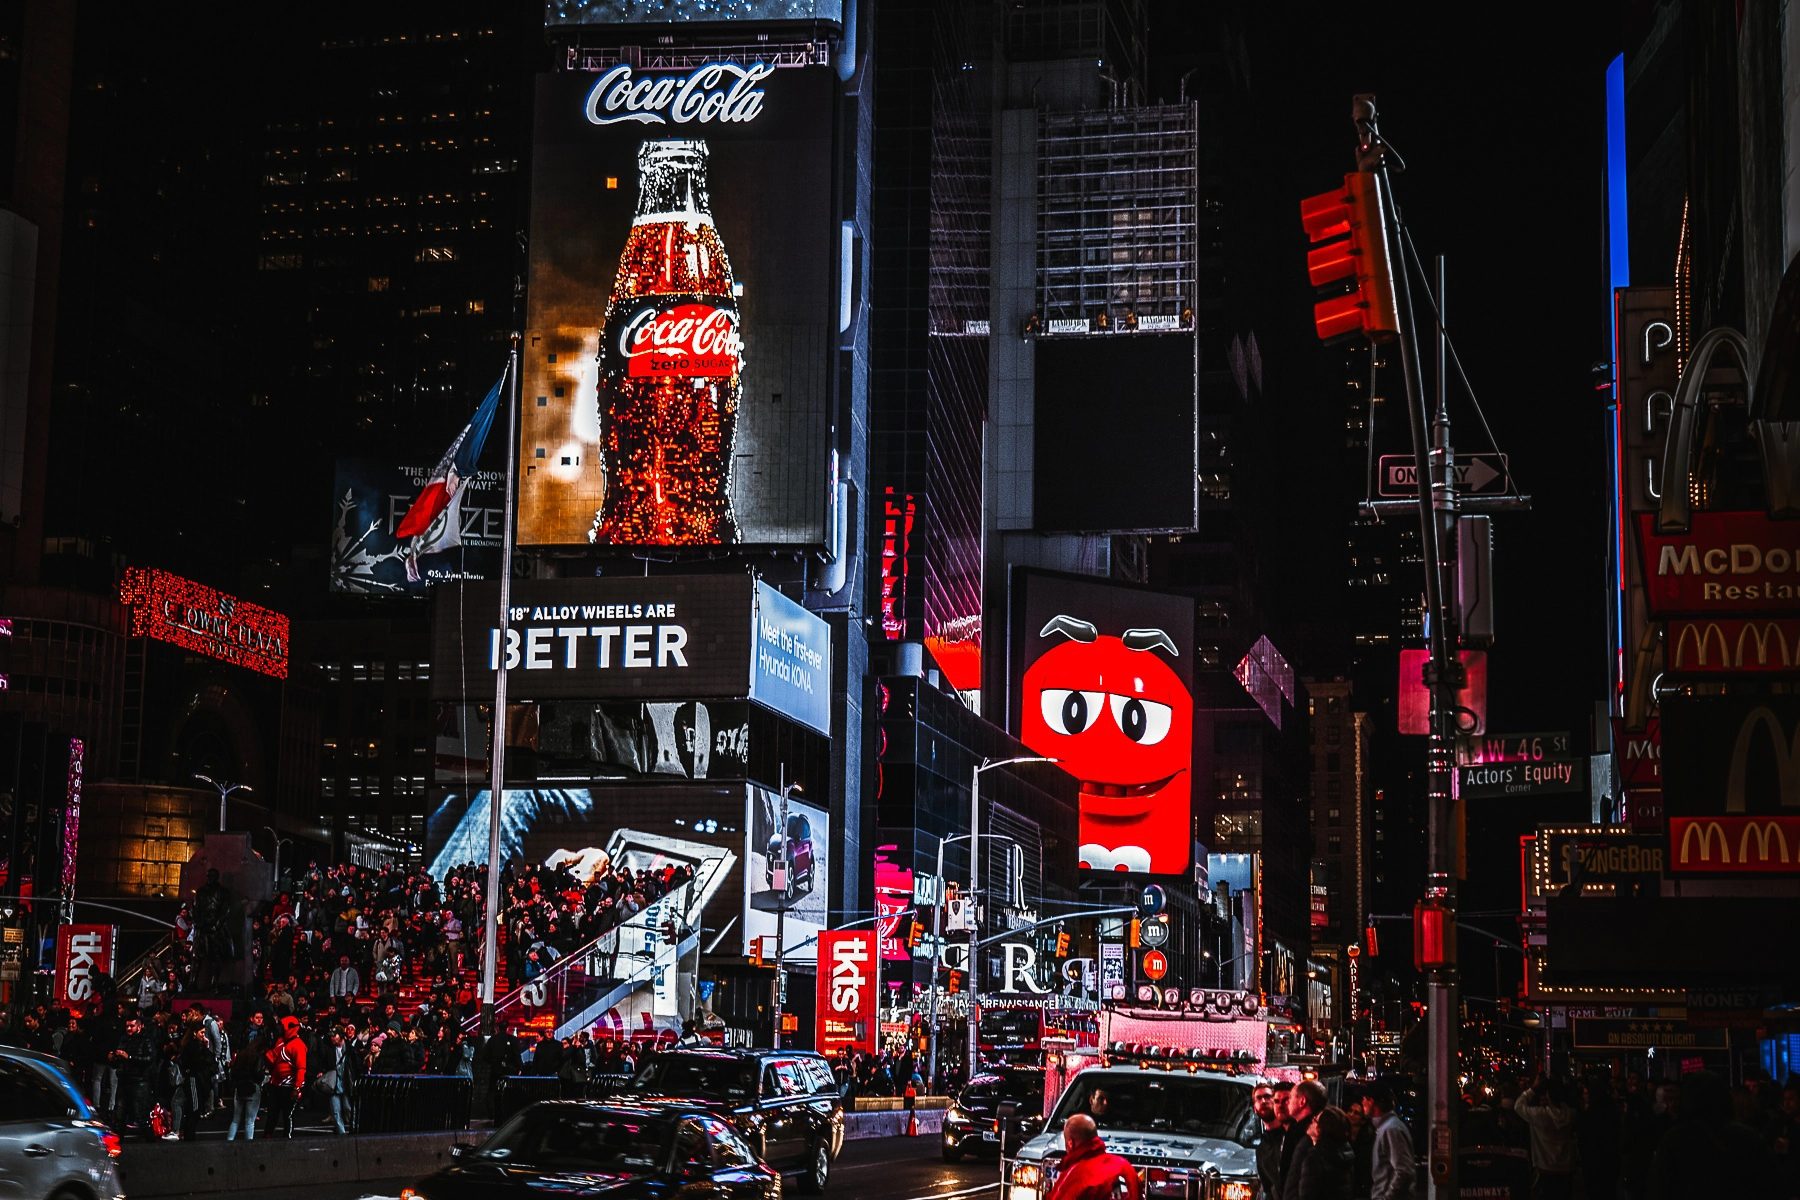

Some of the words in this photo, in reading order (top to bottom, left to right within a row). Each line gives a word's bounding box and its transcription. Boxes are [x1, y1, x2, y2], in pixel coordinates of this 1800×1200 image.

[585, 63, 776, 125] Coca-Cola
[1395, 467, 1418, 483] ON
[1657, 543, 1800, 576] McDo
[1704, 581, 1800, 601] Resta
[533, 605, 579, 620] ALLOY
[582, 604, 643, 619] WHEELS
[646, 603, 676, 618] ARE
[239, 625, 283, 656] PLAZA
[491, 624, 690, 671] BETTER
[760, 615, 780, 647] Meet
[781, 628, 793, 655] the
[793, 634, 823, 671] first-ever
[759, 645, 791, 682] Hyundai
[1487, 739, 1506, 762] W
[1517, 737, 1544, 761] 46
[1553, 736, 1567, 752] St
[1466, 765, 1518, 786] Actors'
[1524, 762, 1573, 786] Equity
[1505, 784, 1532, 793] Corner
[68, 931, 103, 1002] tkts
[831, 937, 869, 1013] tkts
[986, 999, 1055, 1012] RENAISSANCE
[1621, 1032, 1660, 1045] ABSOLUTE
[1459, 1186, 1511, 1198] ROADWAY'S
